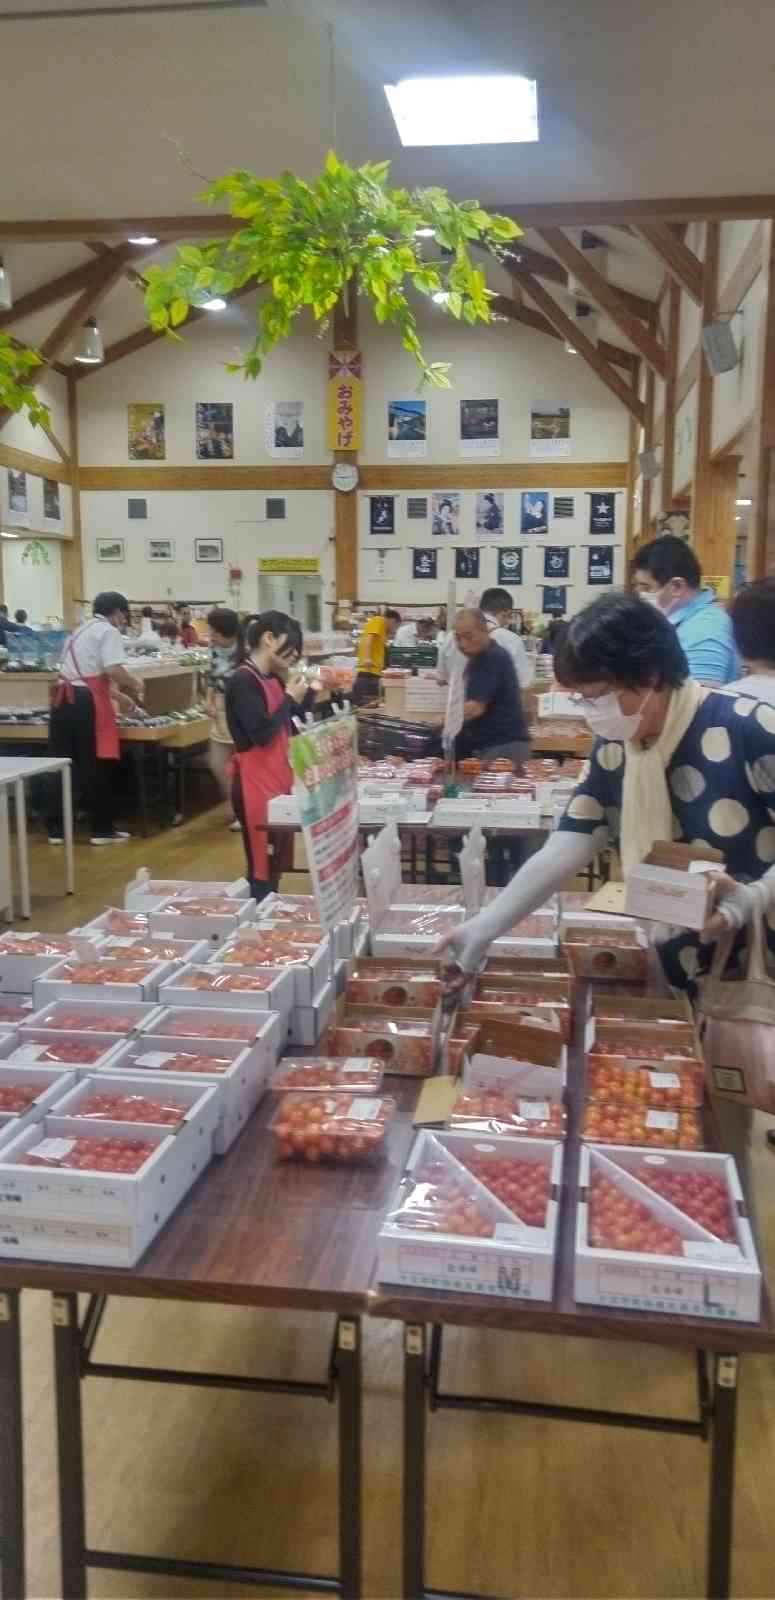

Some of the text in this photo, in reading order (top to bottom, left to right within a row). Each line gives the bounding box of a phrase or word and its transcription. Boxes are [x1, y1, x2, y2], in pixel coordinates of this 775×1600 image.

[336, 384, 354, 447] おみやげ
[497, 1266, 522, 1290] M
[703, 1281, 723, 1307] L
